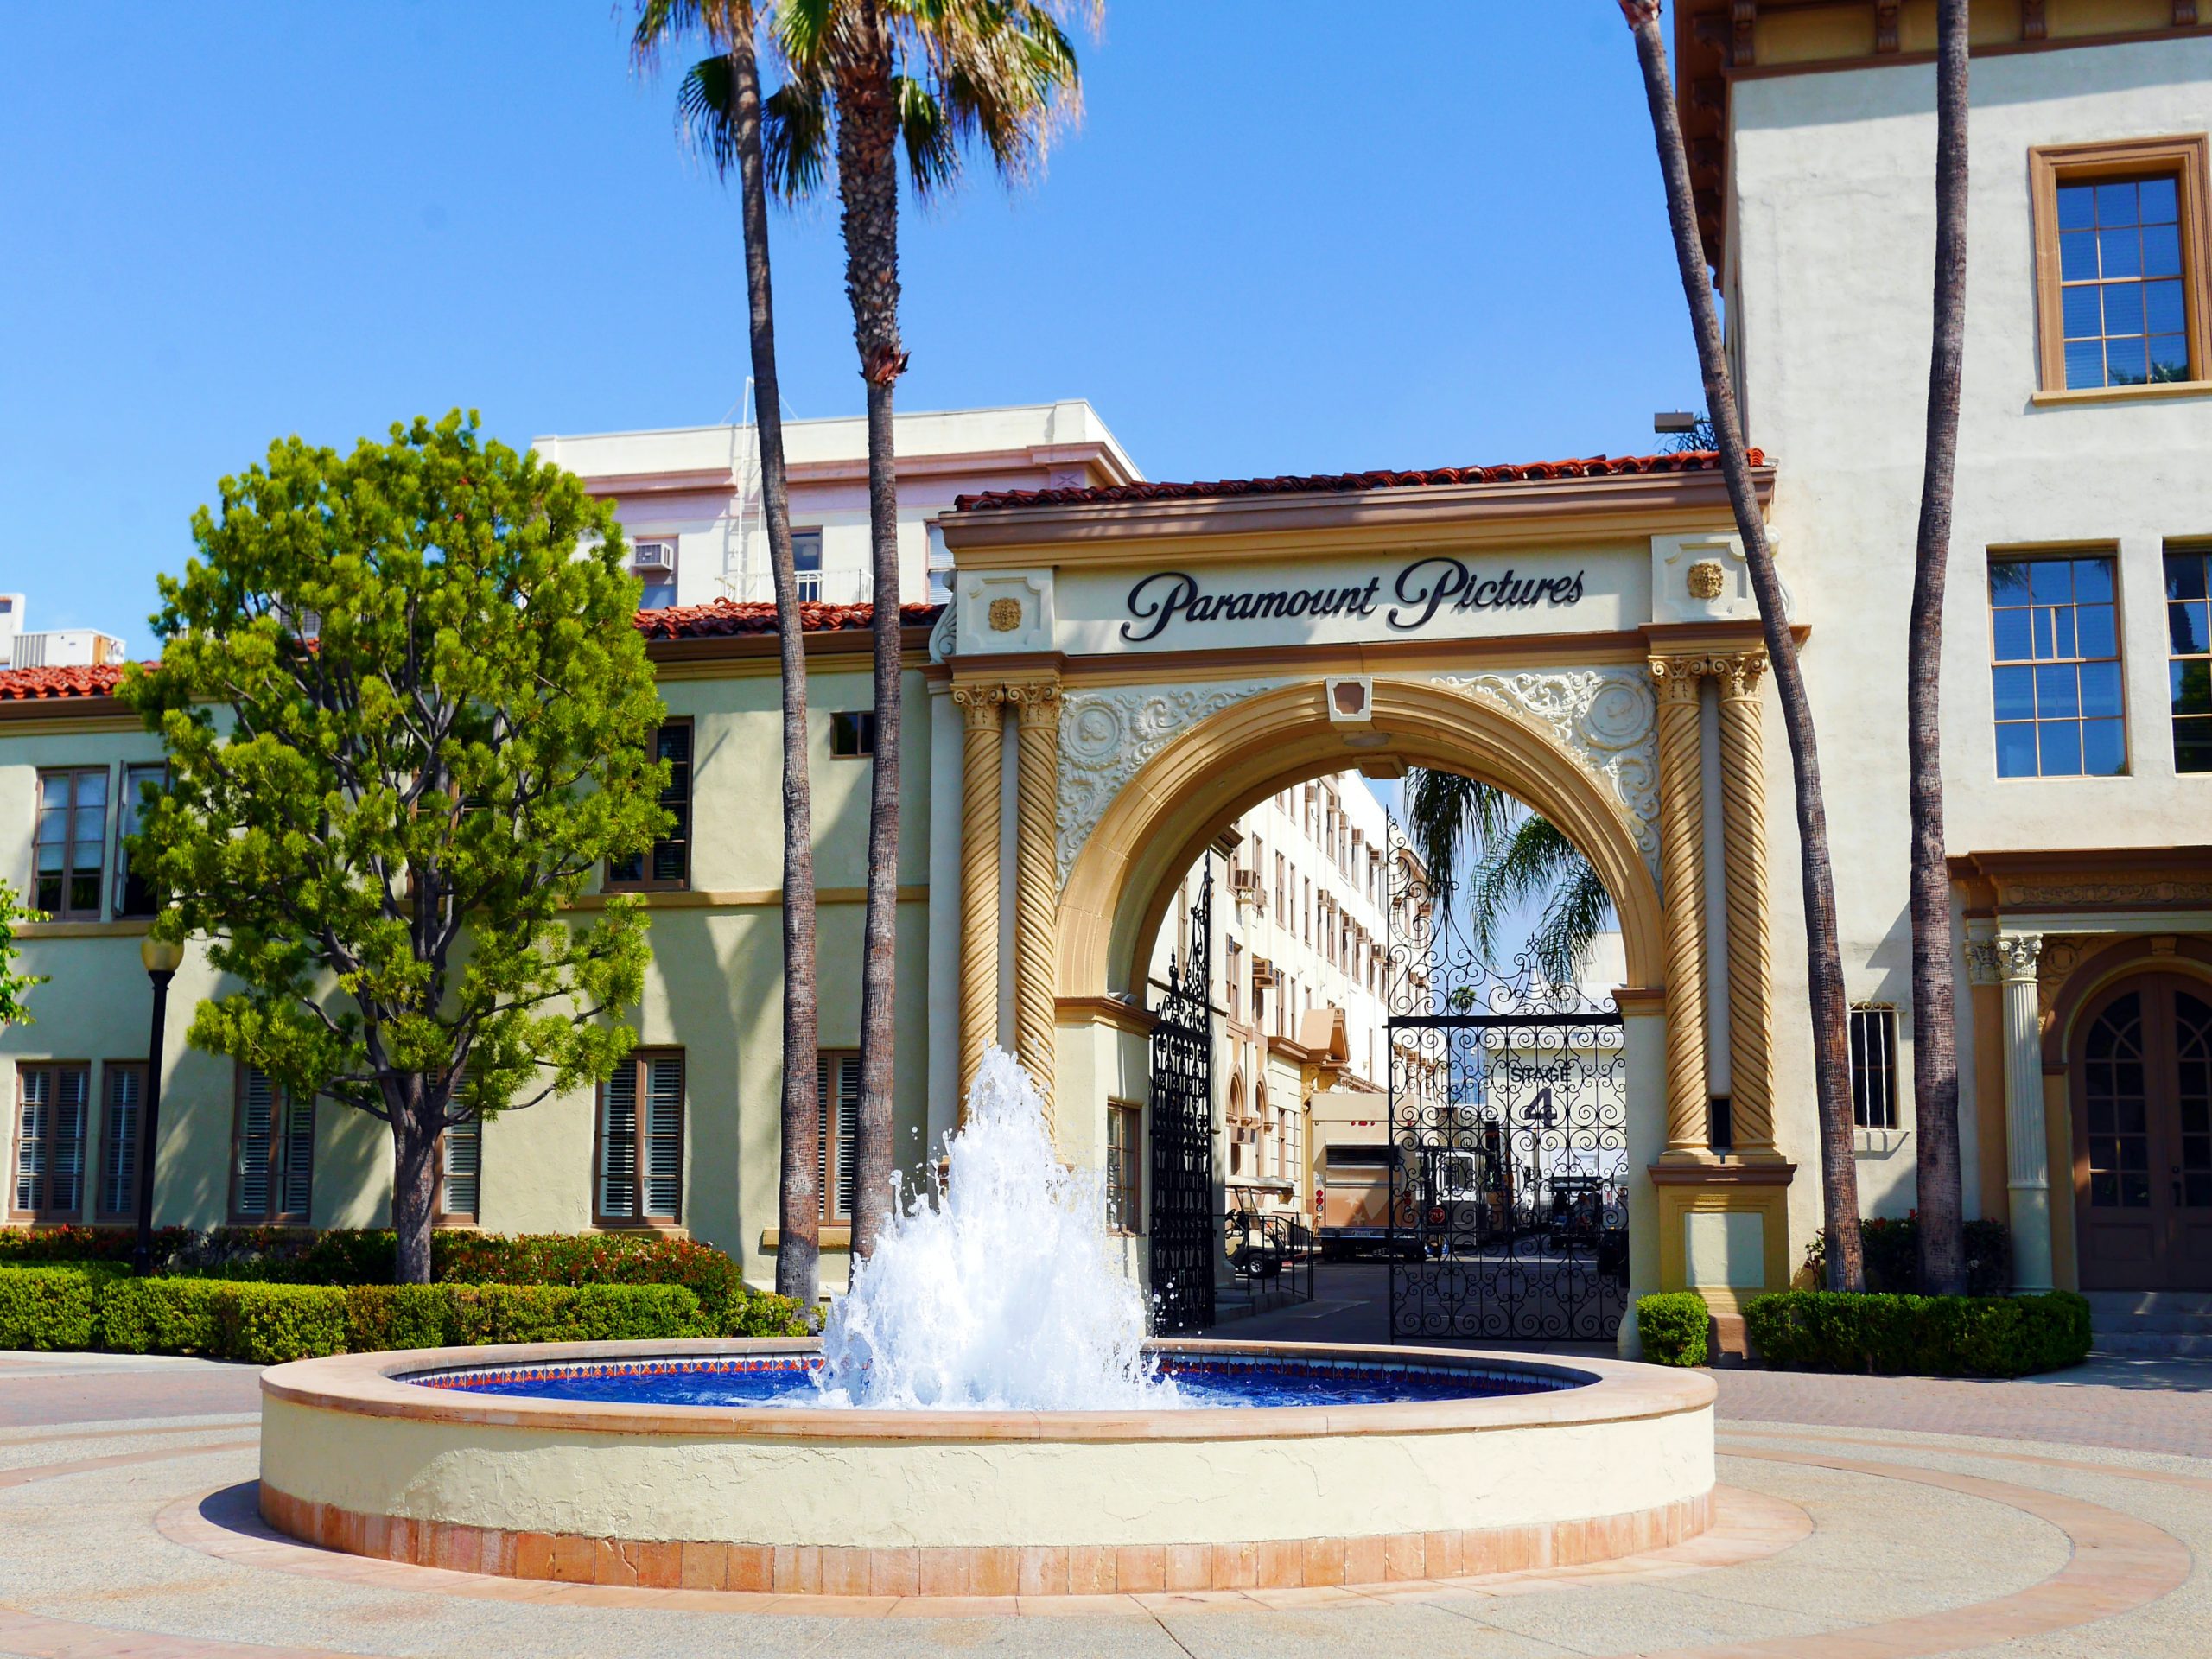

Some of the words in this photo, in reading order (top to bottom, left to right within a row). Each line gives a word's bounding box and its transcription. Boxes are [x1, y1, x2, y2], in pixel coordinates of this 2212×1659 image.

[1121, 572, 1381, 642] Paramount
[1389, 557, 1585, 629] Pictures
[1510, 1067, 1572, 1083] STAGE
[1524, 1088, 1558, 1128] 4
